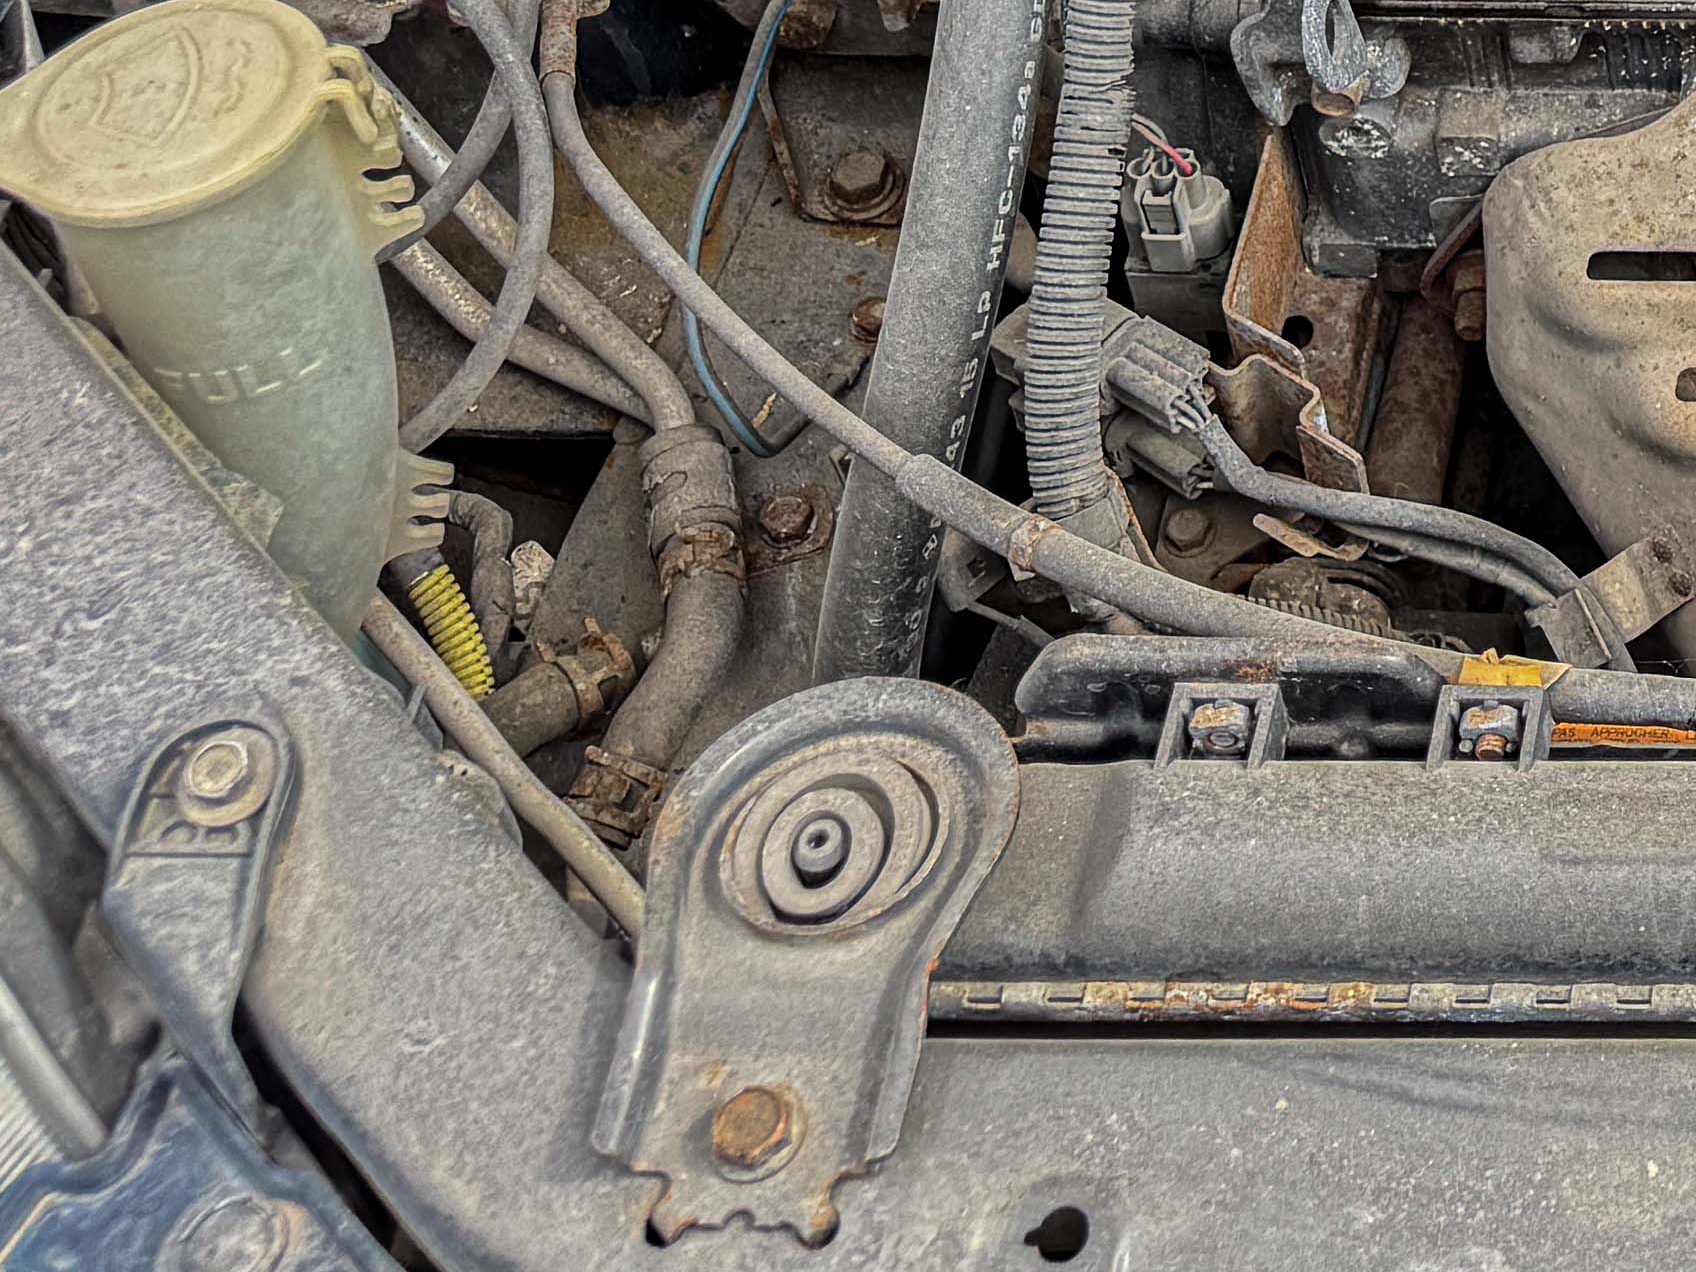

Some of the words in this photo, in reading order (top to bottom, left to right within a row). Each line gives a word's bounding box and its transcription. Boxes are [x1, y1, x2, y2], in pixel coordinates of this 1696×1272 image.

[986, 60, 1037, 271] HFC-134a
[152, 347, 323, 406] FULL
[959, 357, 979, 399] 15
[970, 290, 993, 341] LP
